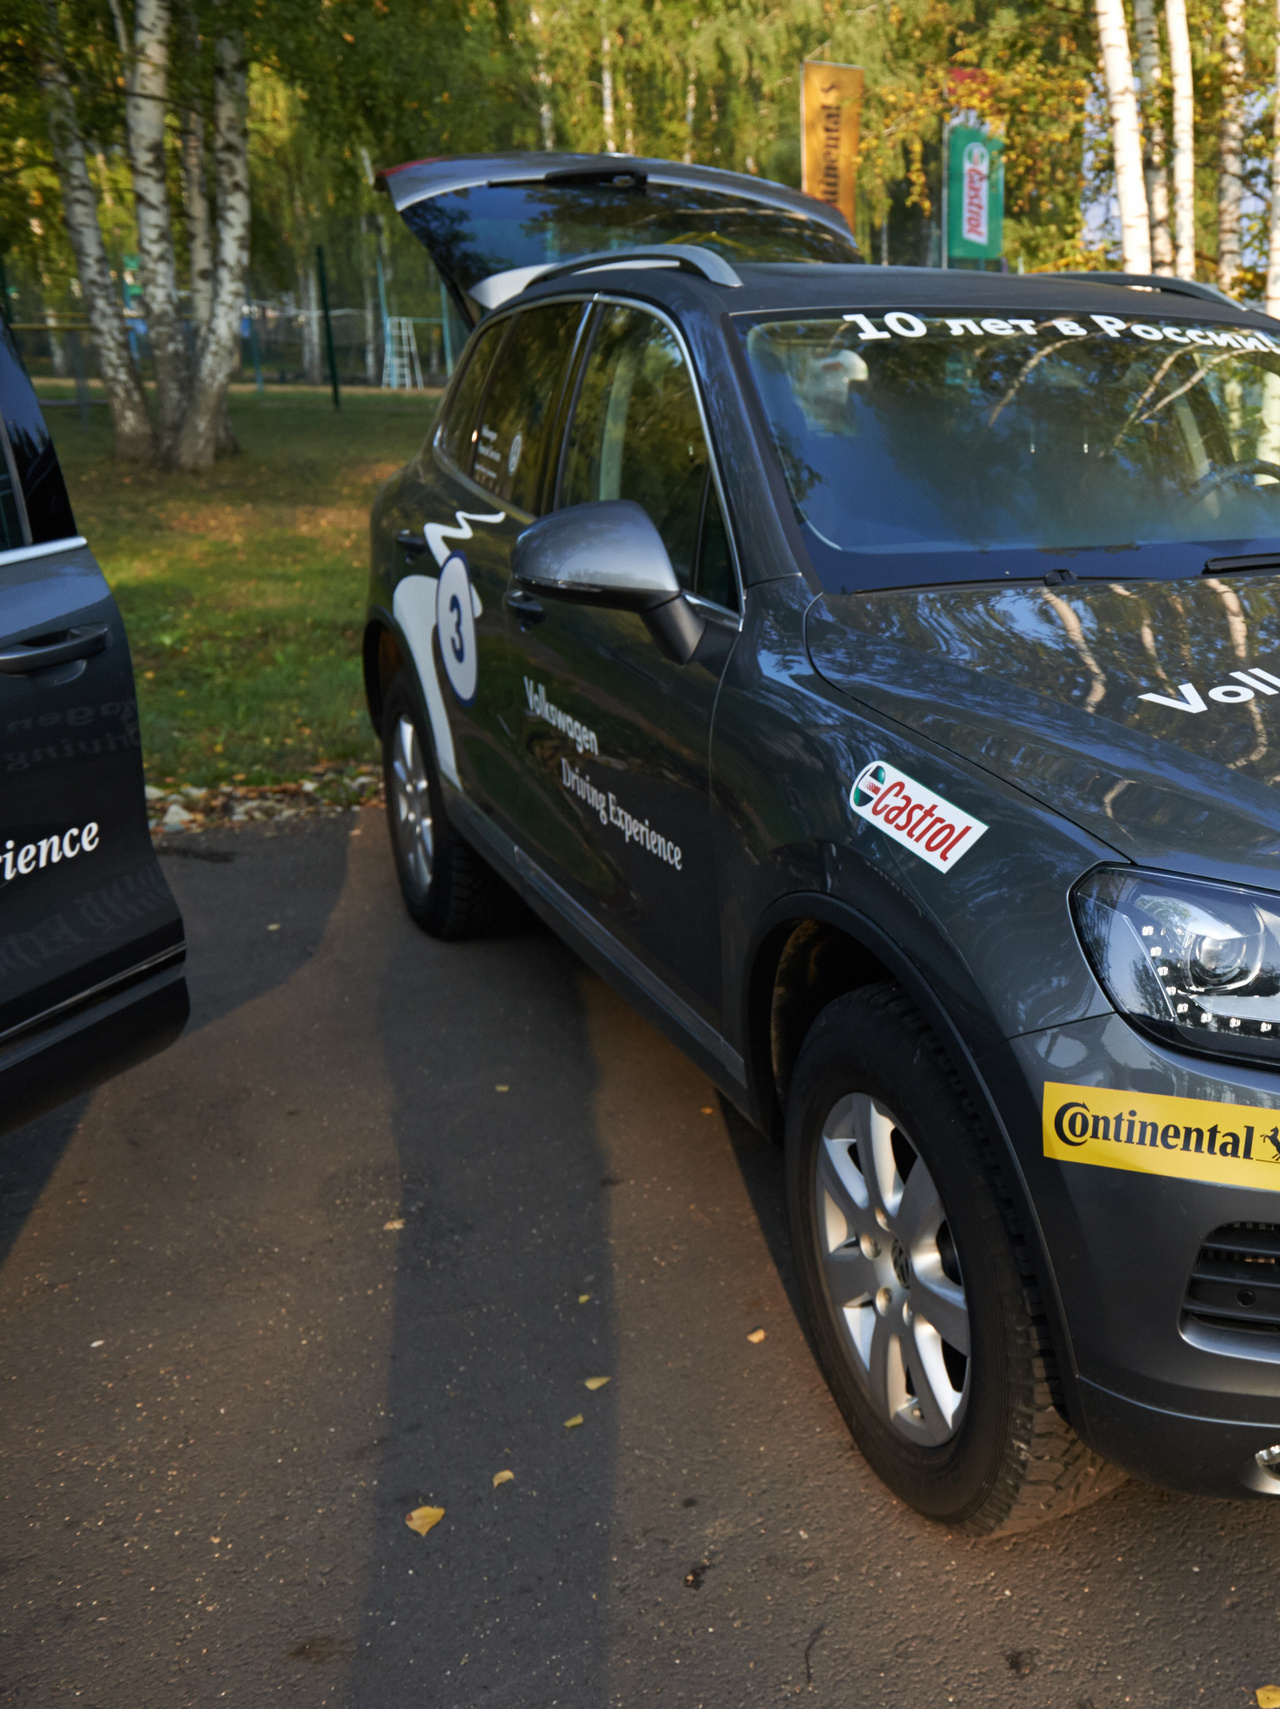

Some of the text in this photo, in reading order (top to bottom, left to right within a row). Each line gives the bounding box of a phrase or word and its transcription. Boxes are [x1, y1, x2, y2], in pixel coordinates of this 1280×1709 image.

[965, 166, 989, 238] Castrol
[842, 310, 928, 341] 10
[944, 318, 1037, 337] лет
[1051, 318, 1088, 337] в
[449, 593, 466, 665] 3
[523, 675, 598, 755] Volkswagen
[561, 757, 683, 871] Driving Experience
[871, 781, 972, 862] Castrol
[0, 821, 99, 880] ience
[1054, 1101, 1255, 1160] Continental
